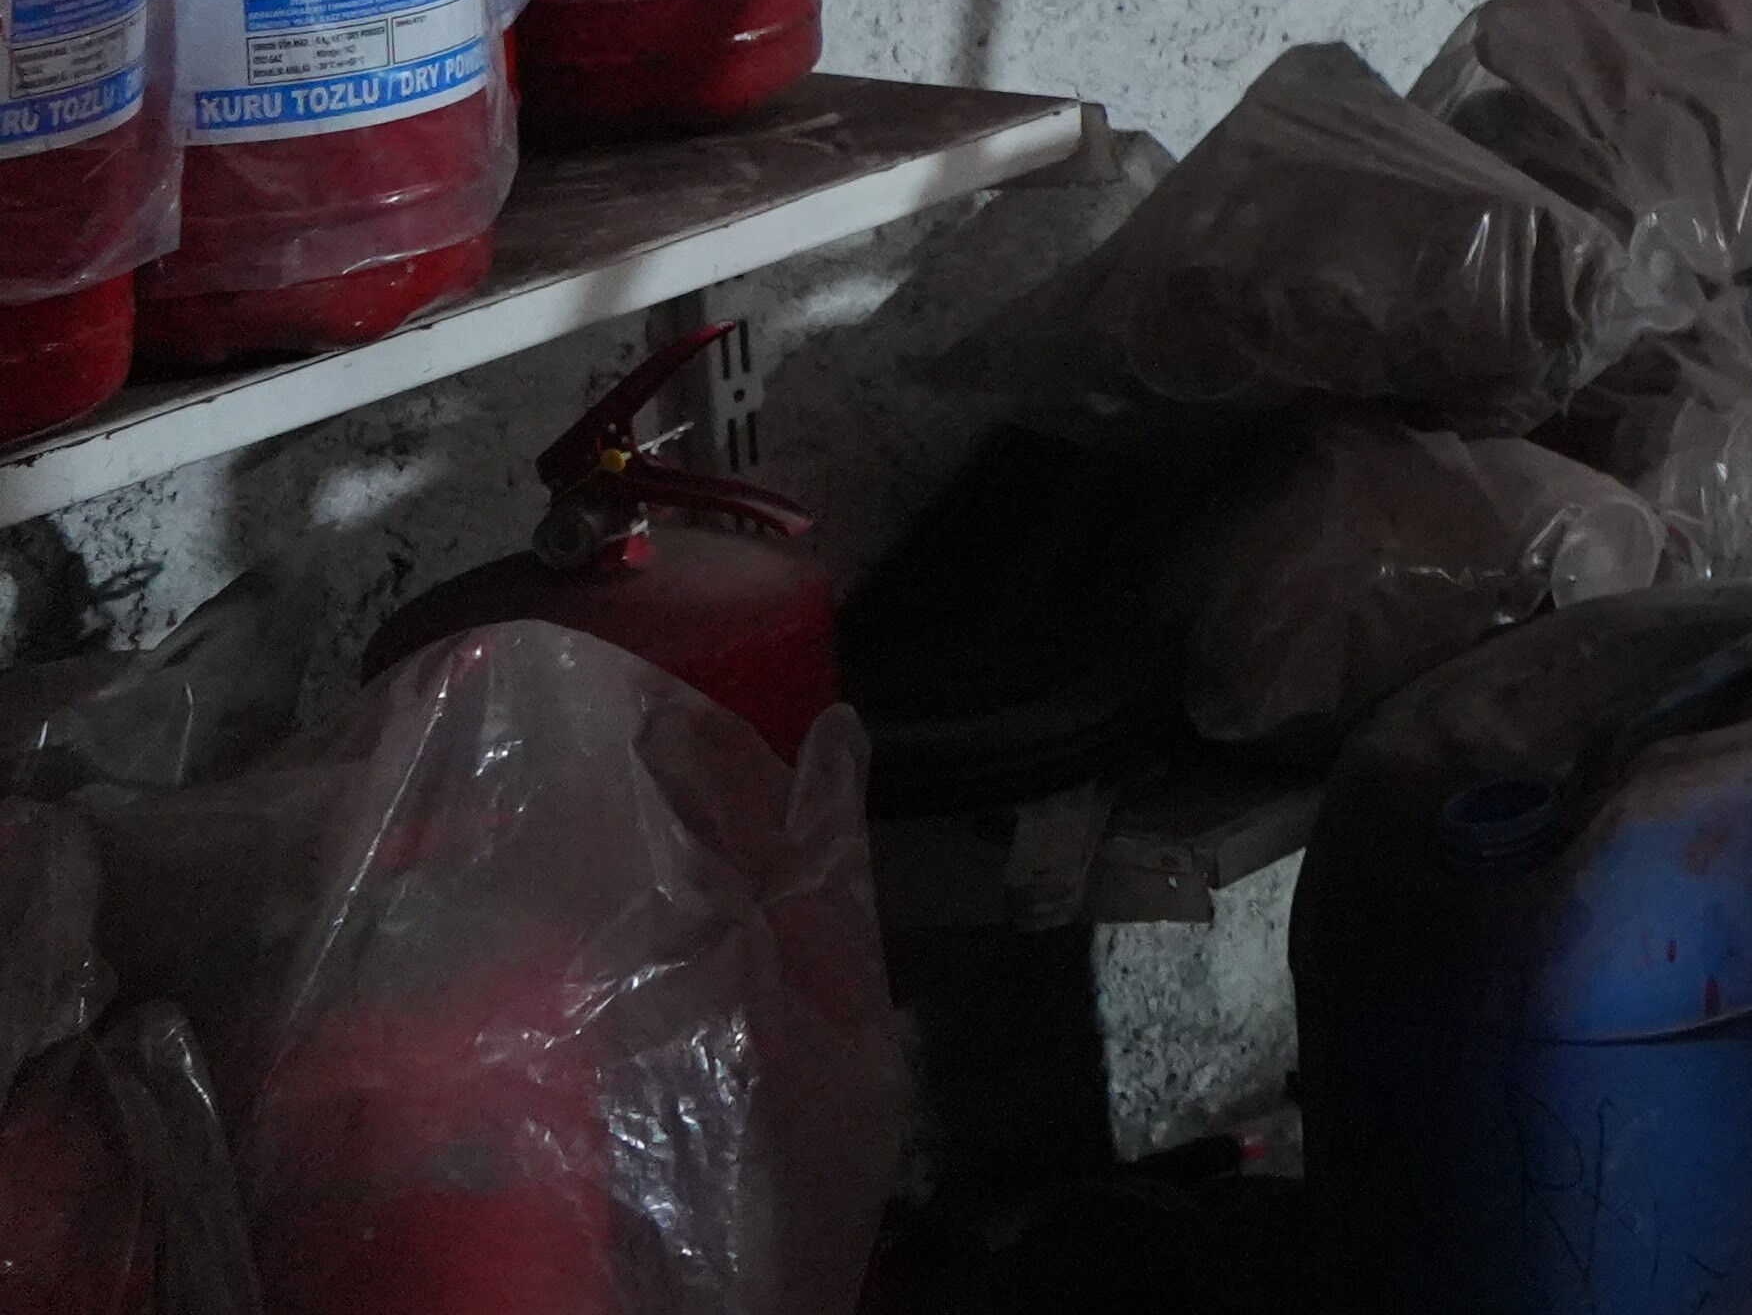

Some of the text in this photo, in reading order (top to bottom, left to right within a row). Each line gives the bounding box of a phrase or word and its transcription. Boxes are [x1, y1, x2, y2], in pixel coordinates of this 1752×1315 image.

[200, 92, 283, 122] KURU
[292, 78, 380, 114] TOZLU
[402, 62, 442, 97] DRY
